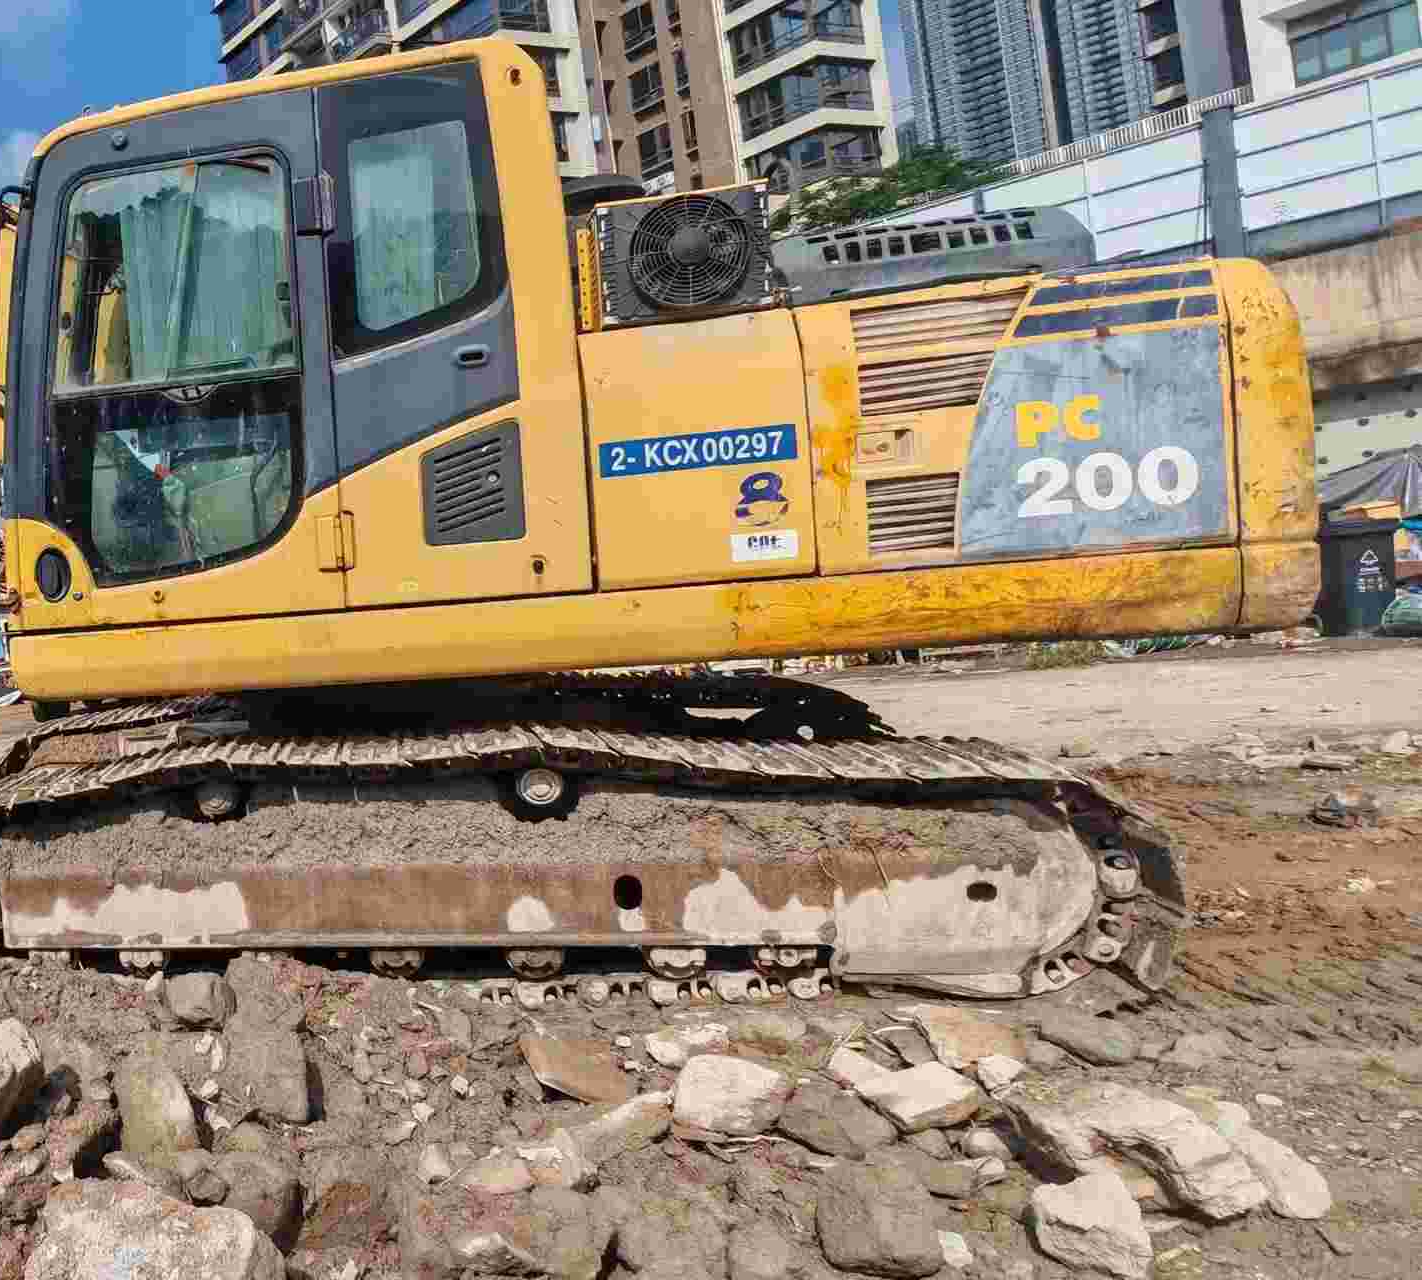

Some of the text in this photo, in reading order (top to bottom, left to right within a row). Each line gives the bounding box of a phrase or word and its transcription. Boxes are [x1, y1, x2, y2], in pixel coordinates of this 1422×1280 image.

[1015, 394, 1101, 448] PC
[643, 431, 784, 468] KCX00297
[1016, 446, 1199, 518] 200
